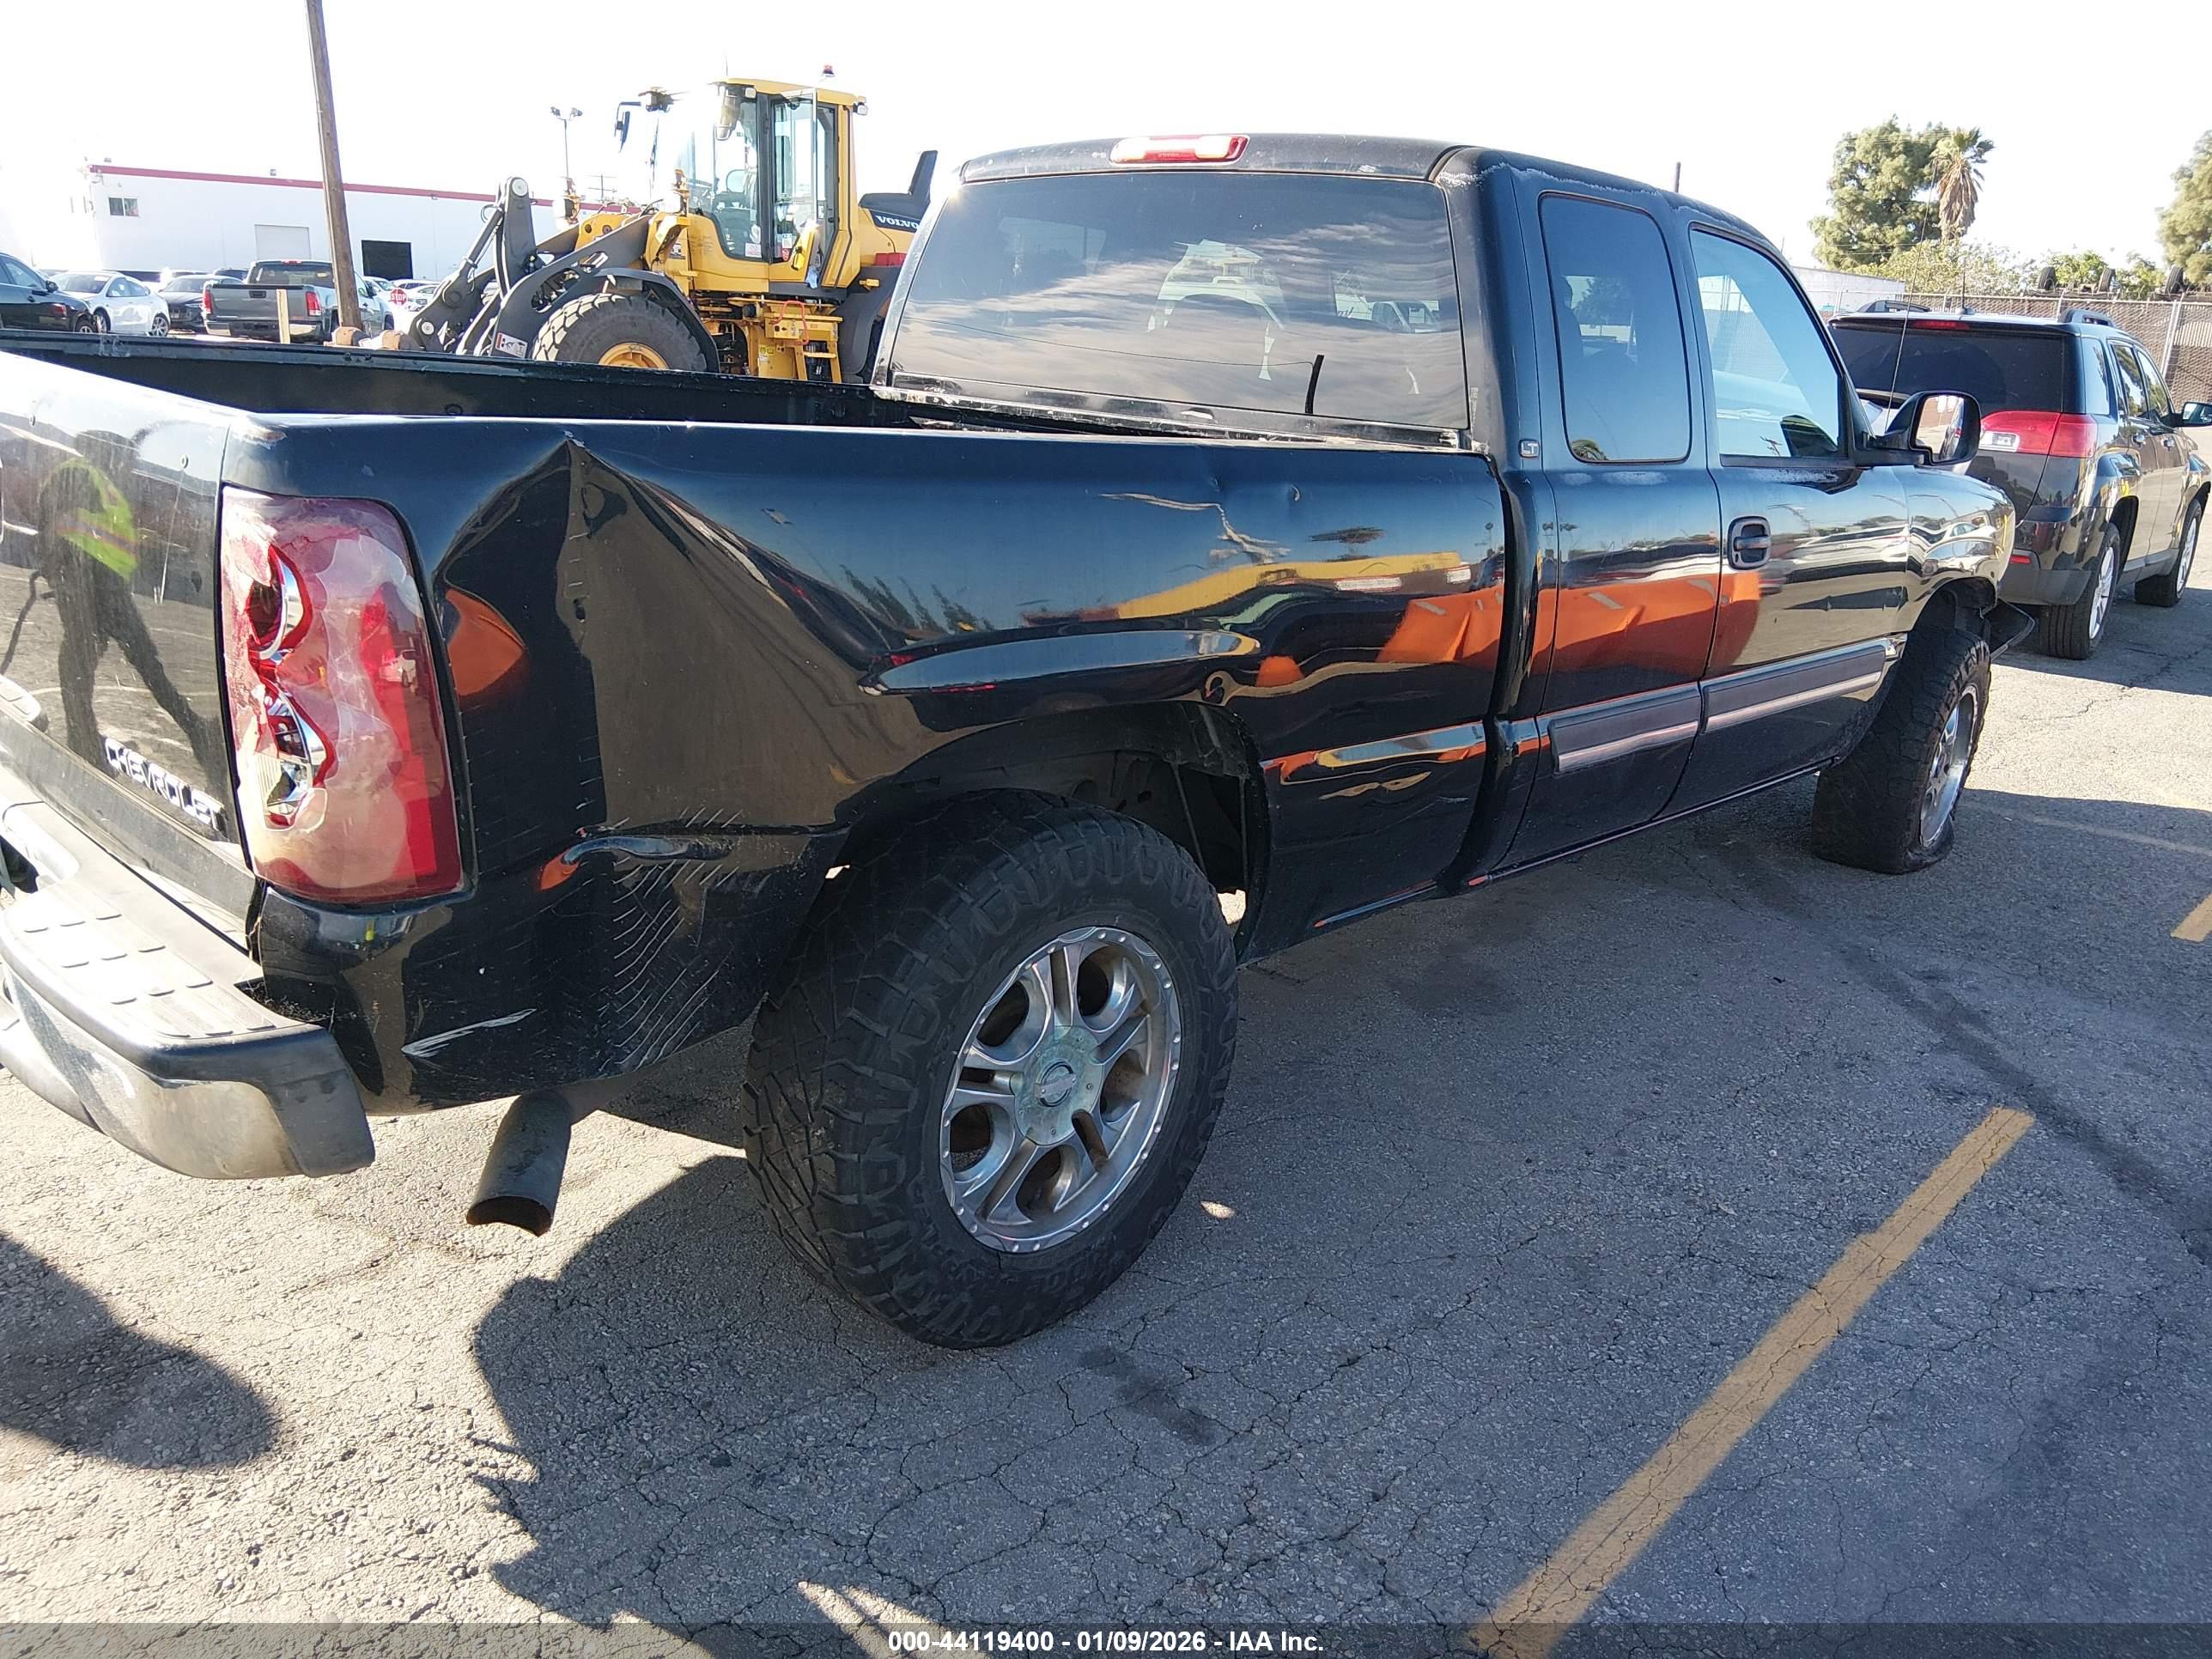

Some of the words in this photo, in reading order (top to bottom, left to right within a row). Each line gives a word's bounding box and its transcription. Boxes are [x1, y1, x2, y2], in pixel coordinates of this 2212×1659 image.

[875, 215, 920, 229] VOLVO
[1521, 442, 1538, 454] LT
[105, 737, 226, 833] CHEVROLET
